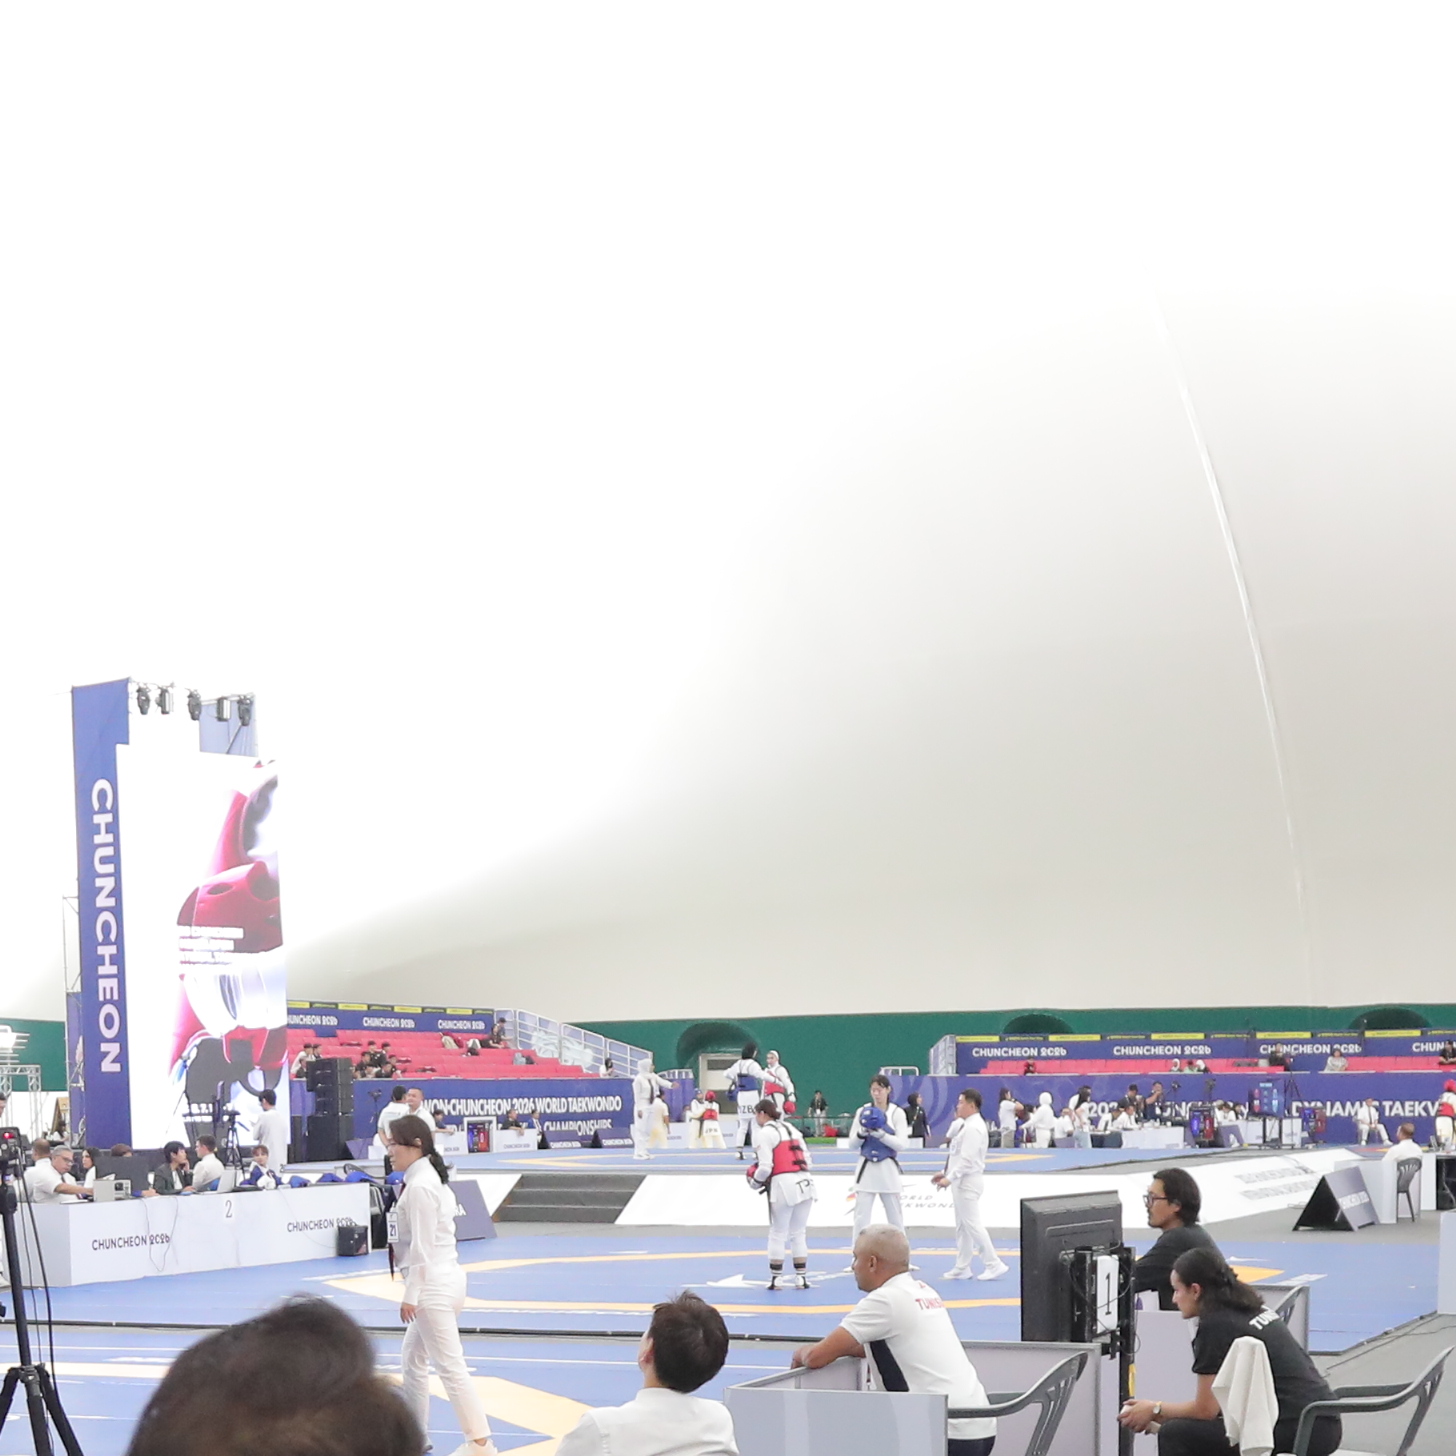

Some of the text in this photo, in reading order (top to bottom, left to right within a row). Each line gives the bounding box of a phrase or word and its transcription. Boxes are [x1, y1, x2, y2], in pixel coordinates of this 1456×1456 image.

[91, 778, 121, 1073] CHUNCHEON
[971, 1046, 1038, 1057] CHUNCHEON
[1113, 1045, 1182, 1056] CHUNCHEON
[536, 1097, 568, 1114] WORLD
[568, 1096, 622, 1112] TAEKWONDO
[225, 1200, 233, 1218] 2
[287, 1218, 335, 1233] CHUNCHEON
[91, 1234, 147, 1251] CHUNCHEON
[1105, 1271, 1112, 1316] 1
